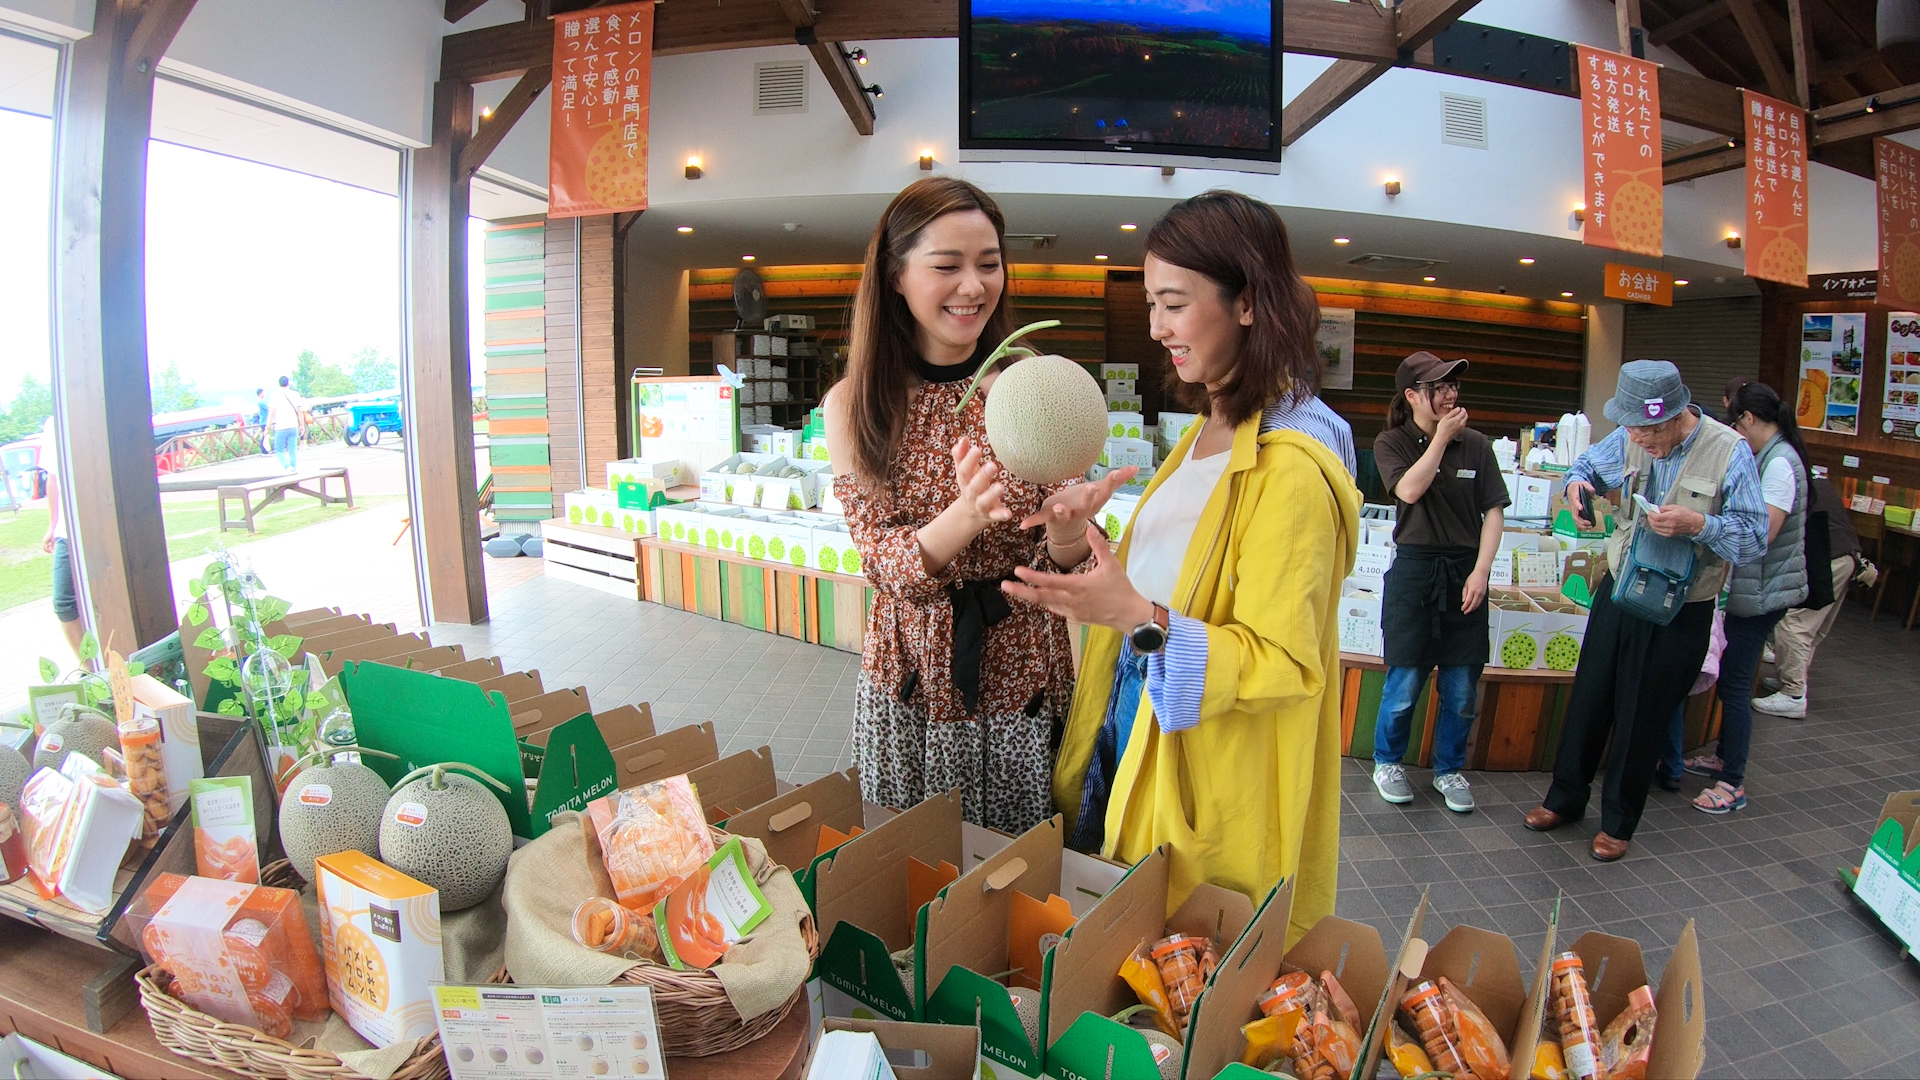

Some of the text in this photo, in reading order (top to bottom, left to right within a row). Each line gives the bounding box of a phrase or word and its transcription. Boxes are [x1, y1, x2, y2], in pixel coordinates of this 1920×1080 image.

[561, 21, 580, 127] 贈って満足！
[581, 17, 600, 125] 選んで安心！
[602, 13, 622, 122] 食べて感動！
[622, 12, 642, 159] メロンの専門店で
[1604, 59, 1620, 133] 地方発送
[1622, 65, 1635, 137] メロンを
[1588, 54, 1606, 228] することができます
[1637, 67, 1652, 158] とれたての
[1764, 105, 1777, 192] 産地直送で
[1779, 111, 1788, 178] メロンを
[1751, 100, 1765, 224] 贈りませんか？
[1790, 113, 1802, 217] 自分で選んだ
[1890, 148, 1899, 209] メロンを
[1899, 151, 1908, 210] おいしい
[1908, 154, 1918, 229] とれたての
[1879, 143, 1890, 288] ご用意いたしました
[1618, 269, 1659, 292] お会計
[1626, 291, 1651, 301] CASHIER
[583, 775, 613, 801] MELON
[354, 950, 365, 994] メロン
[365, 955, 377, 1003] とみた
[830, 972, 906, 1019] TOMITA MELON
[983, 1042, 1027, 1069] MELON
